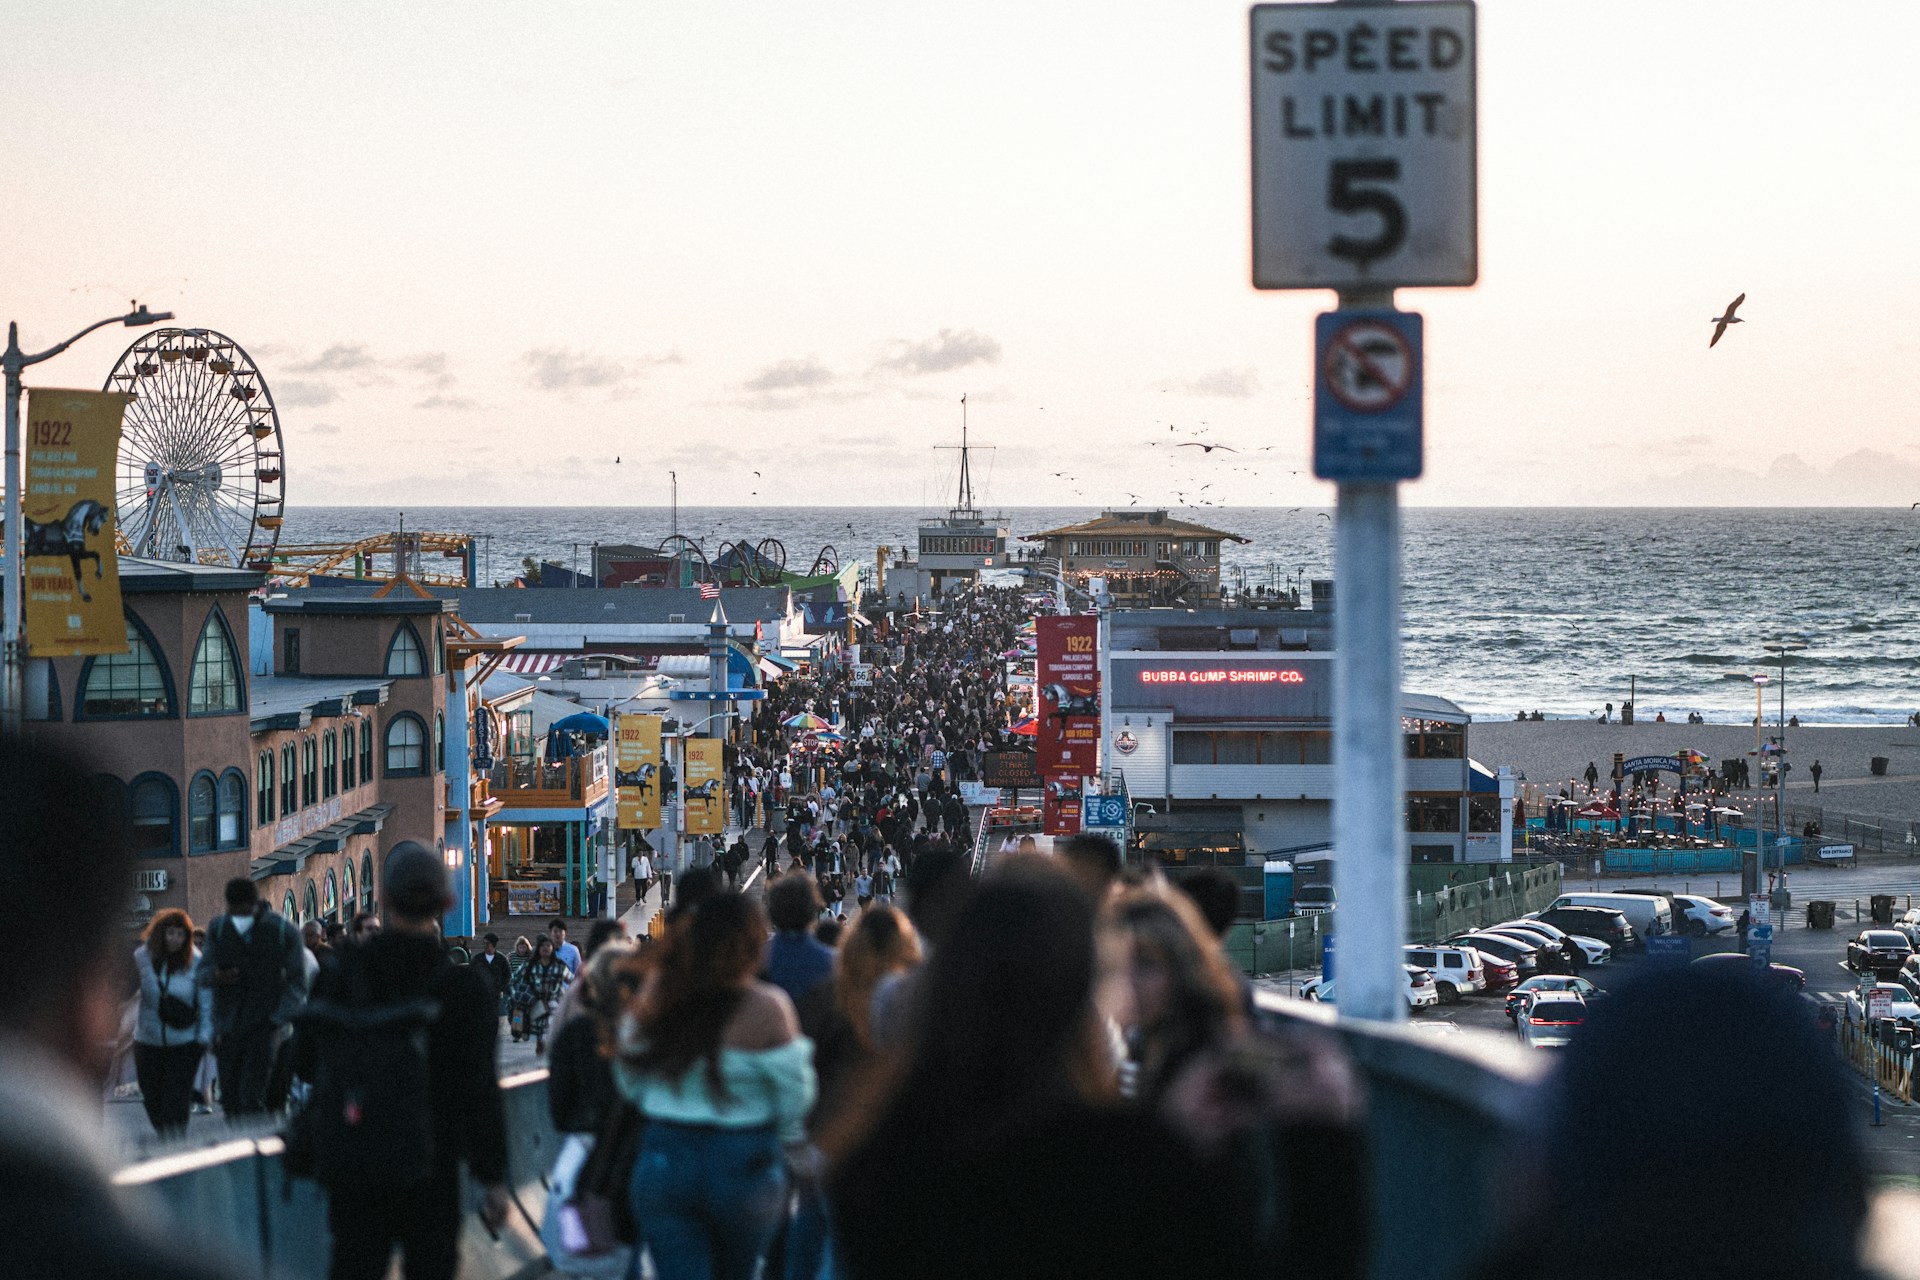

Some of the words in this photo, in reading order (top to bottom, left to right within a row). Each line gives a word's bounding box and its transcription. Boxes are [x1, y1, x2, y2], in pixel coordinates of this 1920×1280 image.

[1263, 27, 1465, 74] SPEED
[1281, 93, 1447, 139] LIMIT
[1326, 157, 1409, 262] 5
[32, 420, 72, 446] 1922
[47, 577, 73, 590] YEARS
[1066, 636, 1093, 652] 1922
[856, 671, 866, 680] 66
[1142, 671, 1187, 682] BUBBA
[1189, 671, 1227, 682] GUMP
[1229, 671, 1277, 682] SHRIMP
[1279, 671, 1304, 682] CO.
[622, 729, 640, 740] 1922
[804, 738, 818, 746] STOP
[688, 751, 704, 760] 1922
[1000, 752, 1028, 760] NORTH
[1000, 761, 1028, 769] STAIRS
[1624, 760, 1642, 769] SANTA
[1644, 757, 1667, 765] MONICA
[1669, 759, 1680, 767] PIER
[999, 769, 1030, 777] CLOSED
[989, 778, 1040, 786] MON-THURS
